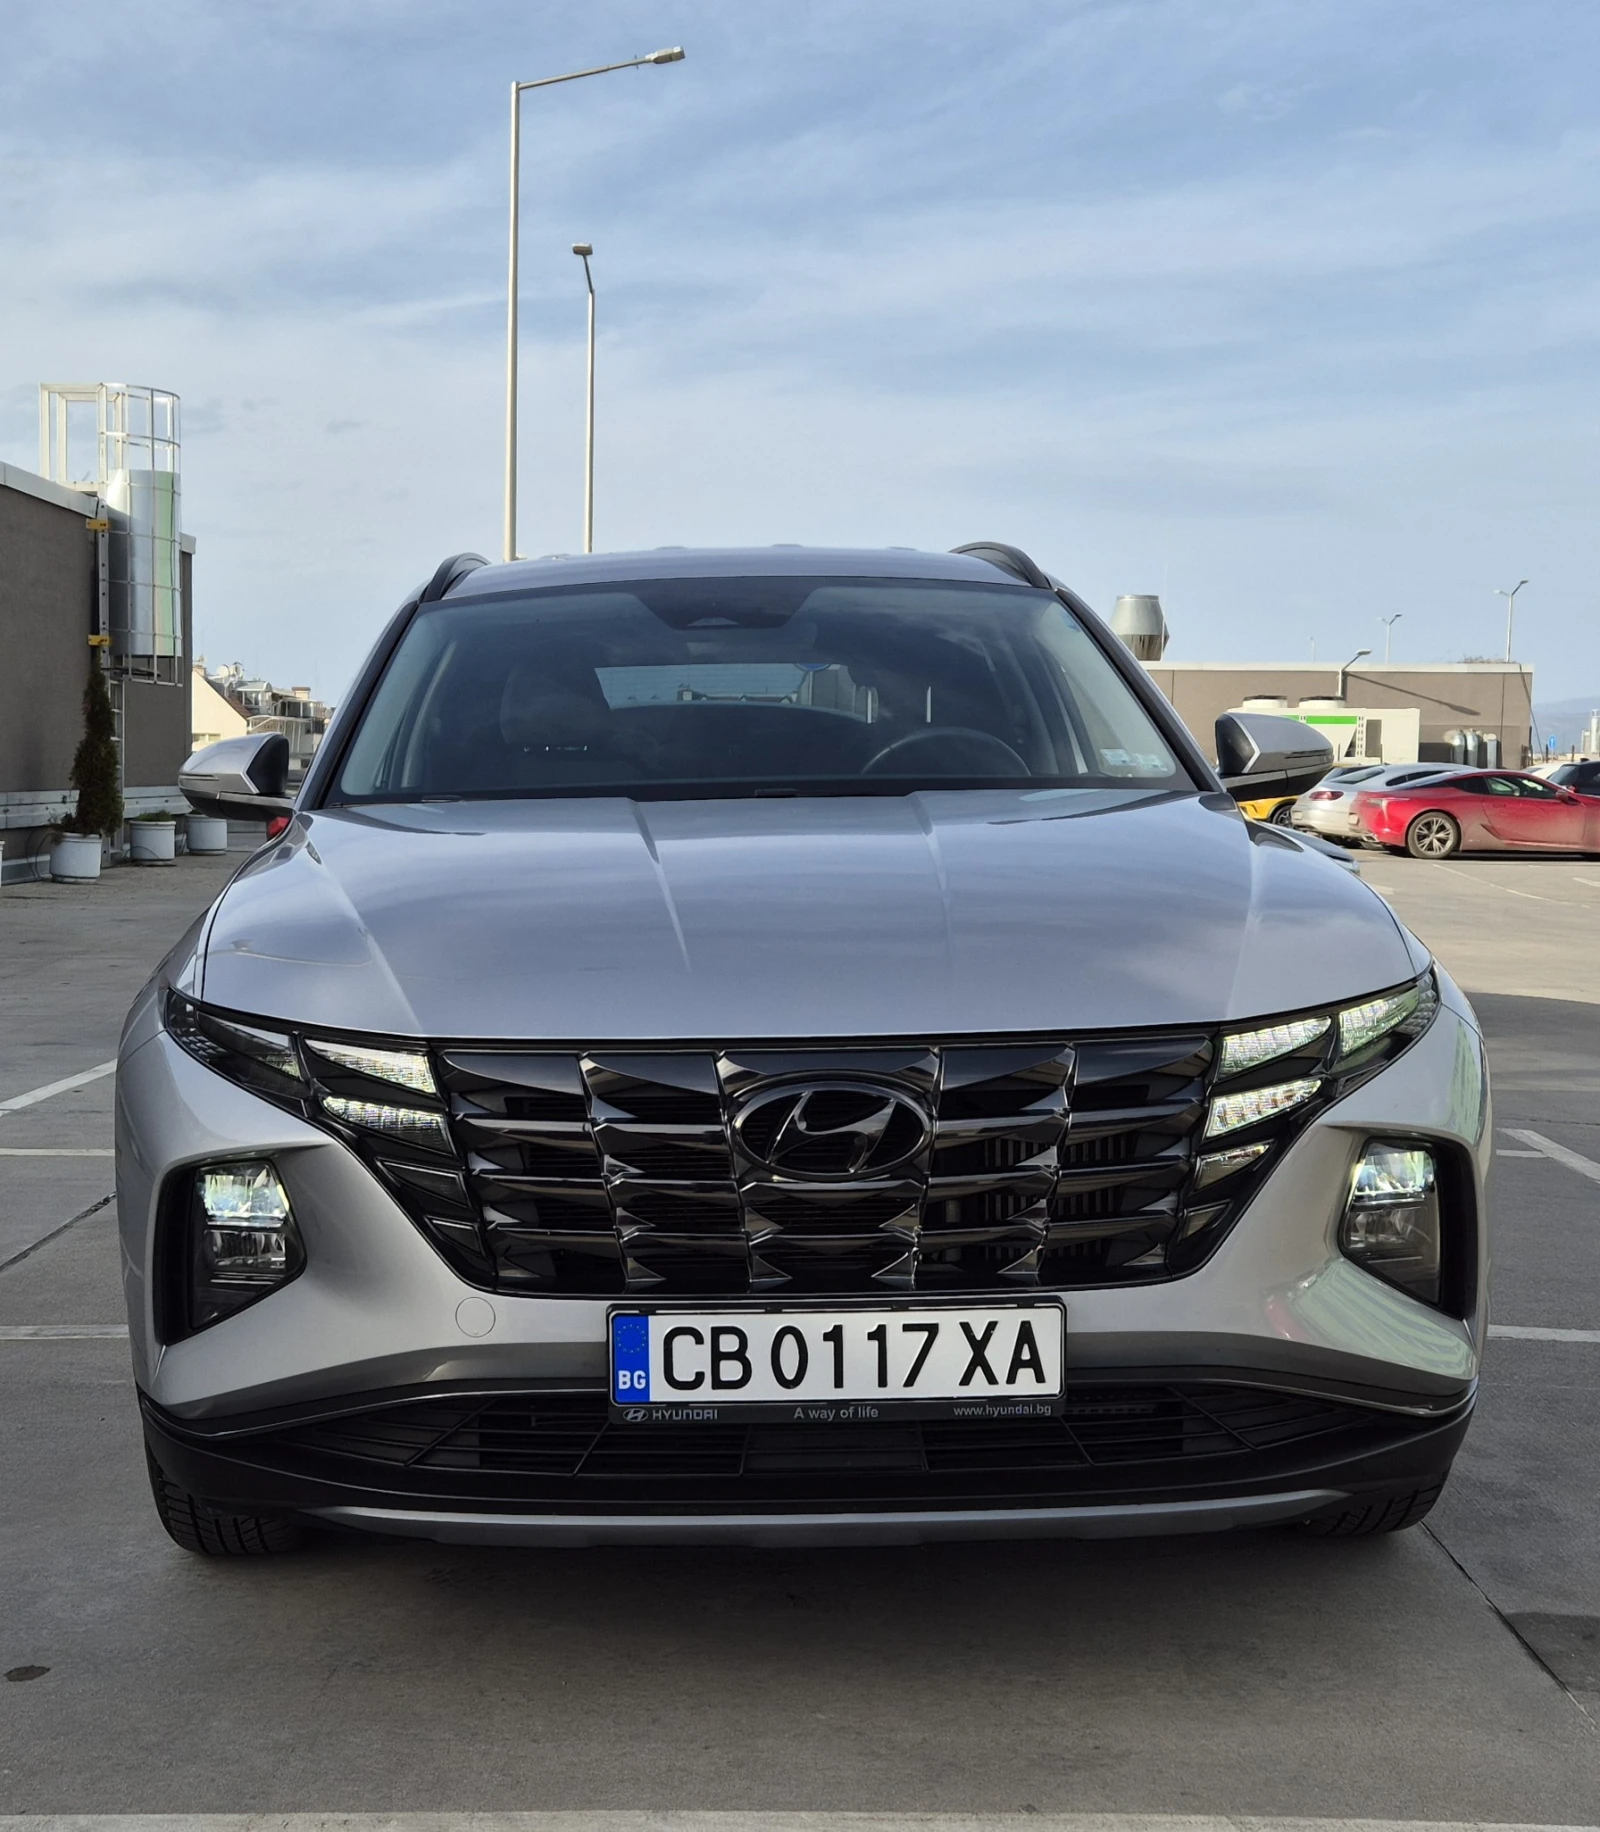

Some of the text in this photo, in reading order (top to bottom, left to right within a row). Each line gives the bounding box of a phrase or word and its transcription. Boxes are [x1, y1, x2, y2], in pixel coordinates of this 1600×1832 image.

[663, 1319, 1047, 1391] CB 0117 XA
[617, 1369, 647, 1390] BG
[651, 1408, 718, 1421] HYUNDAI
[793, 1406, 879, 1421] A way of life
[953, 1403, 1052, 1417] www.hyundai.bg
